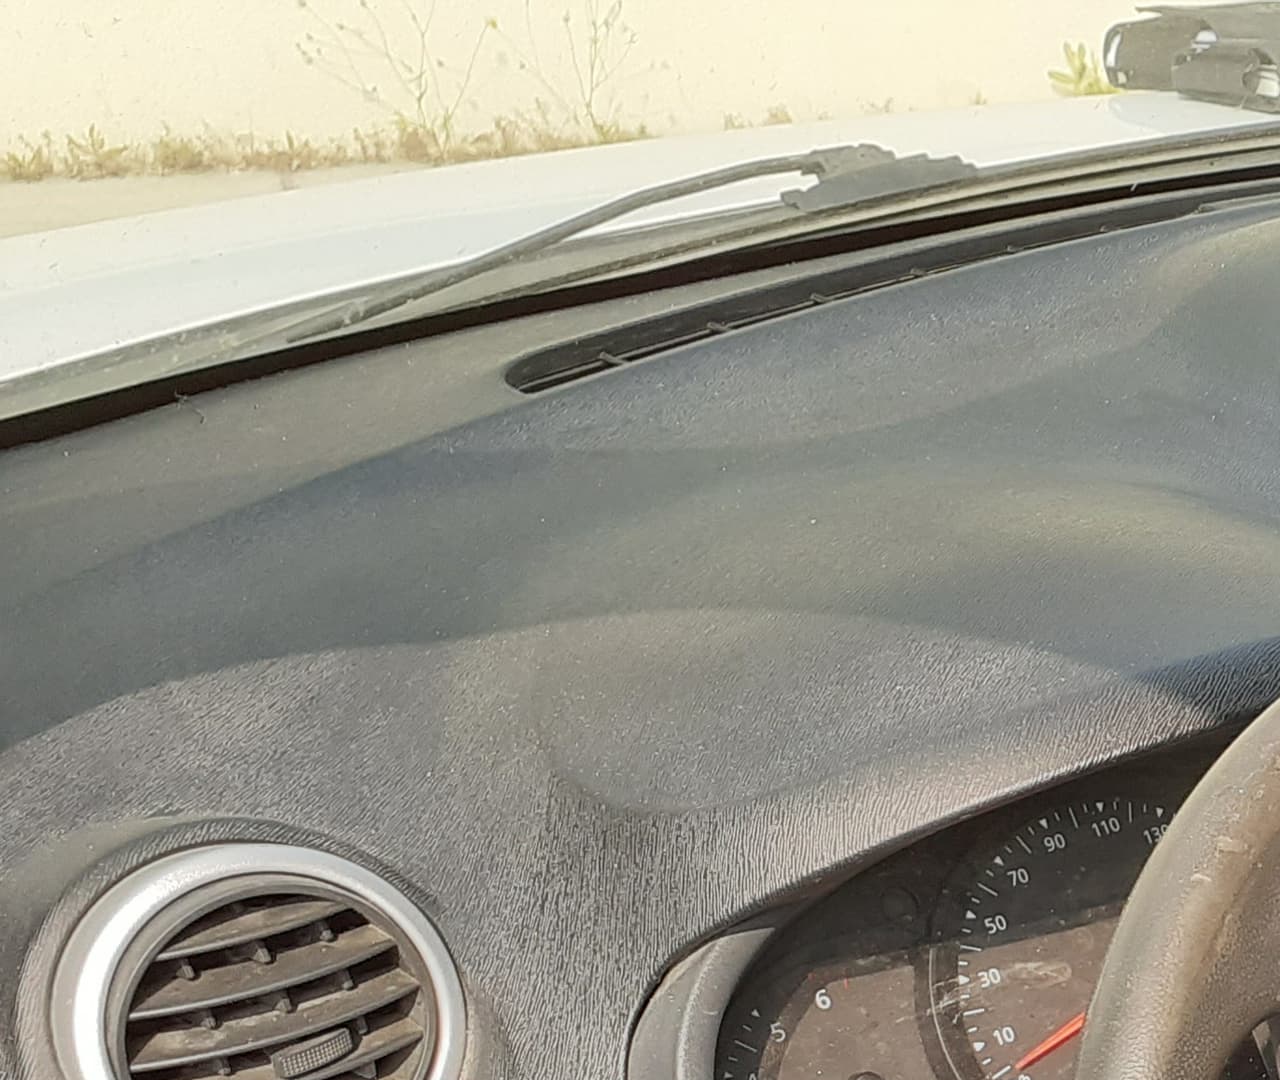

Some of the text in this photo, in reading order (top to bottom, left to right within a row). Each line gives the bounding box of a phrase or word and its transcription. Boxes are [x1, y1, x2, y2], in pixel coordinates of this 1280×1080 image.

[1092, 817, 1120, 837] 110
[1044, 833, 1066, 852] 90
[1007, 868, 1029, 887] 70
[984, 915, 1007, 934] 50
[978, 968, 1001, 988] 30
[815, 989, 832, 1010] 6
[769, 1022, 786, 1042] 5
[993, 1026, 1015, 1045] 10
